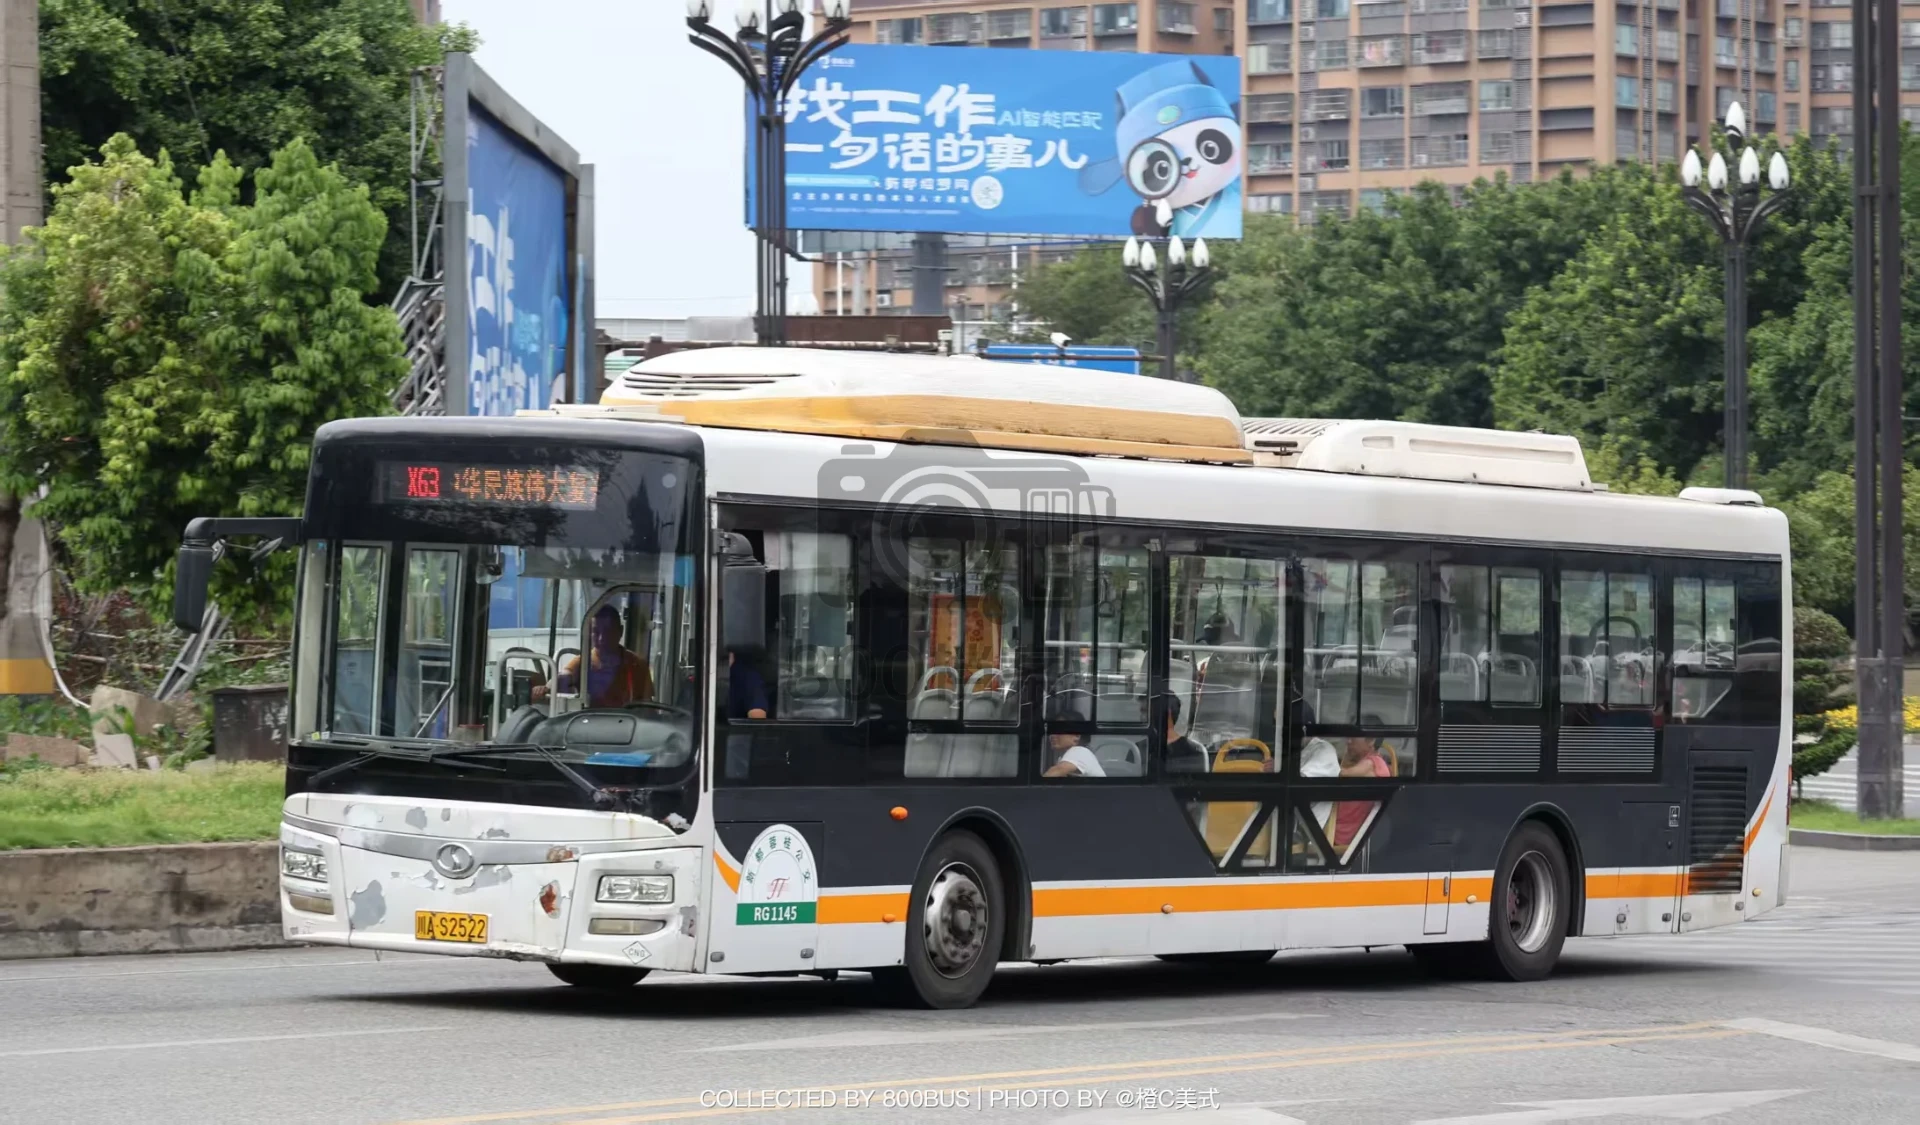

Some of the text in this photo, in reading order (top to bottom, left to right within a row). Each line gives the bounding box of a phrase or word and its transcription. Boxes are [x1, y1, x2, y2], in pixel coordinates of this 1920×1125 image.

[777, 77, 996, 134] 找工作
[784, 130, 1089, 173] 一句话的事儿
[407, 466, 440, 497] X63
[753, 906, 798, 922] RG1145
